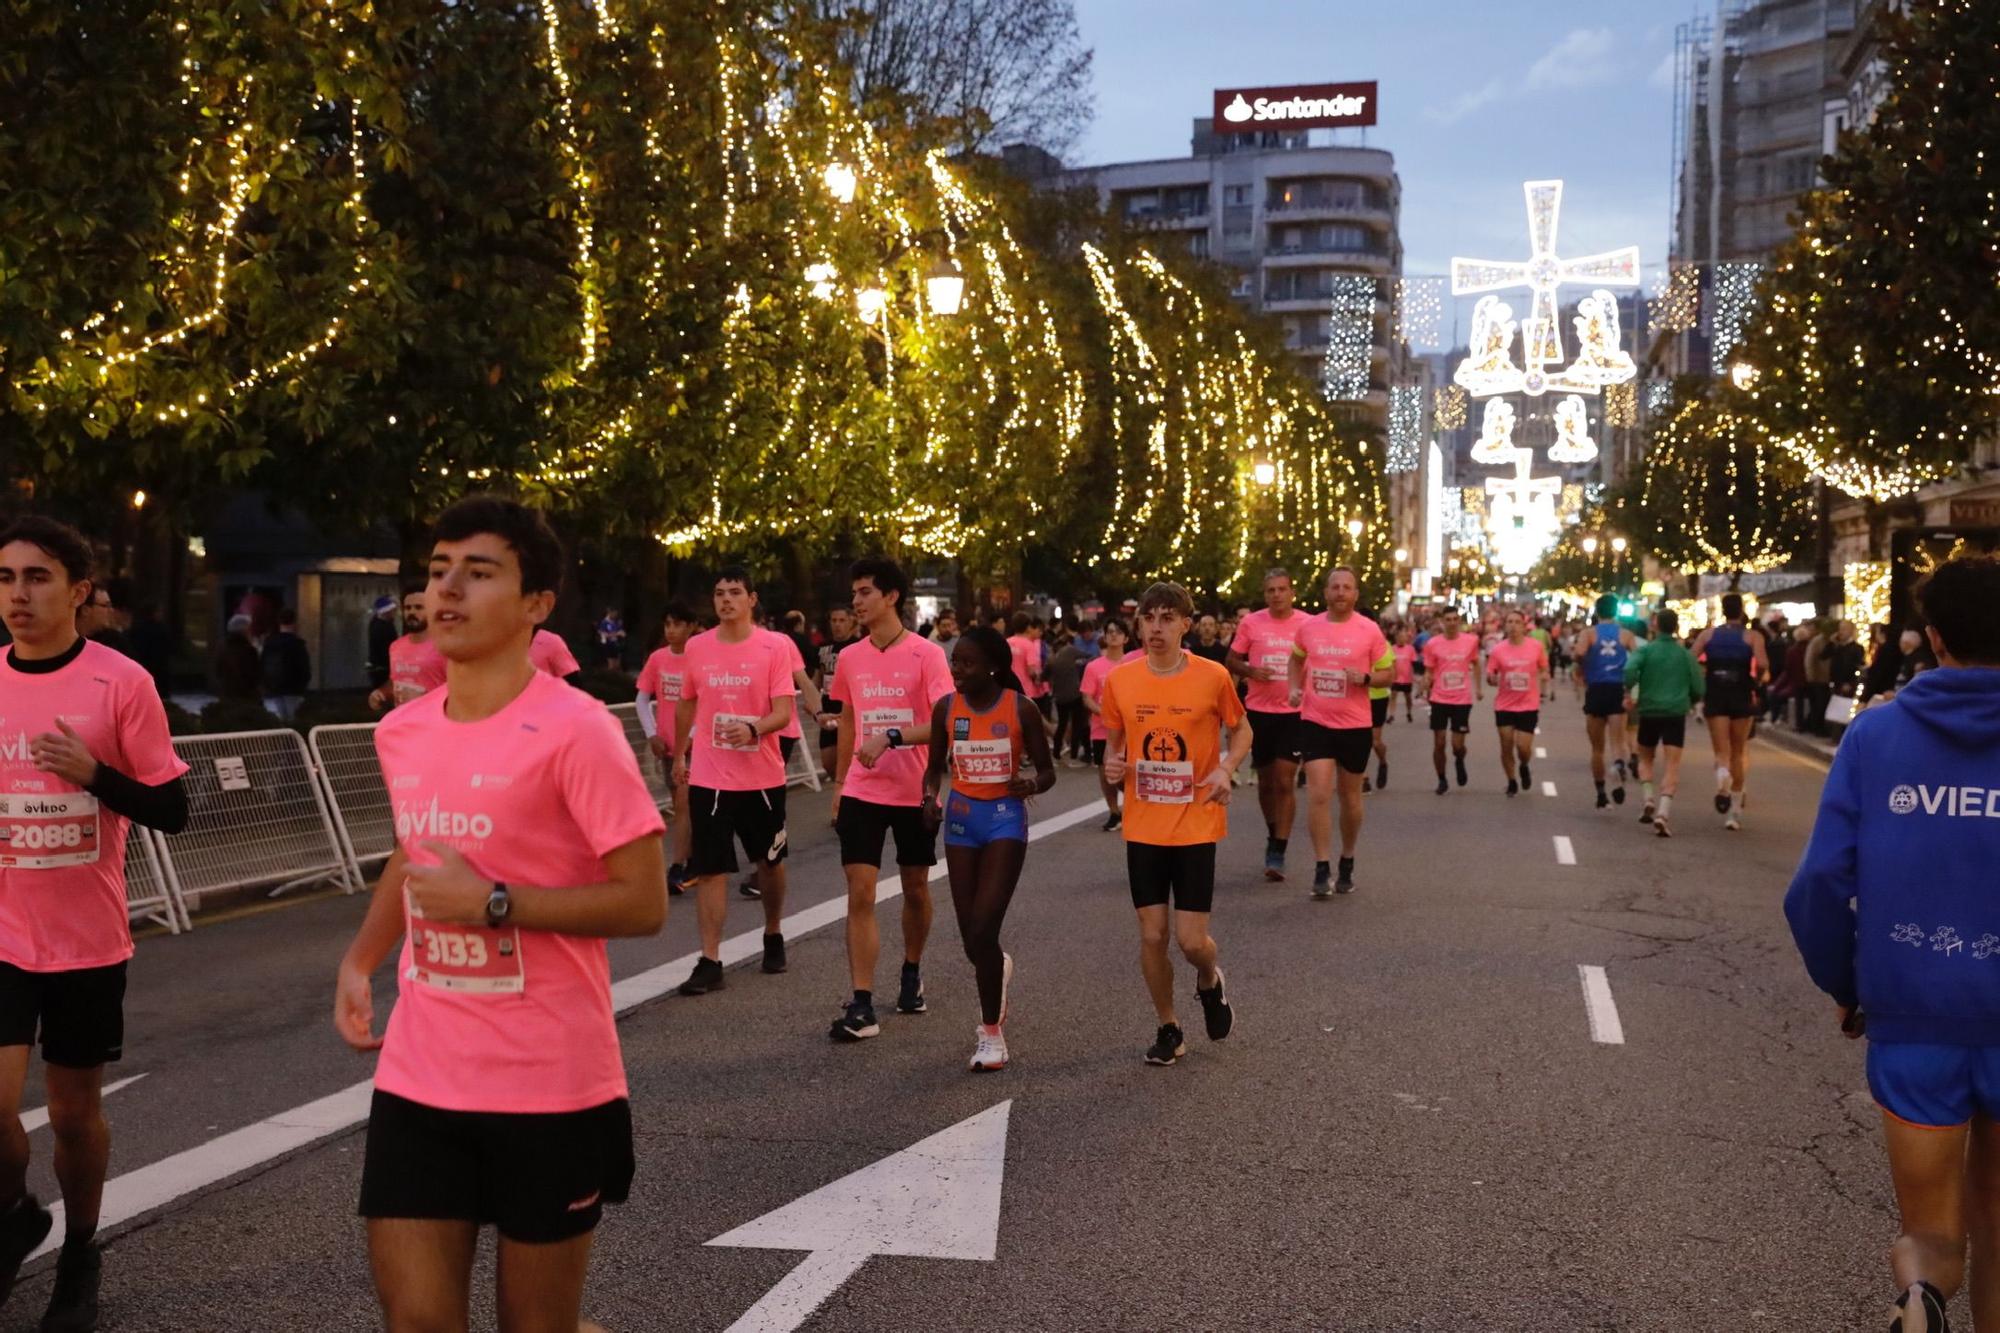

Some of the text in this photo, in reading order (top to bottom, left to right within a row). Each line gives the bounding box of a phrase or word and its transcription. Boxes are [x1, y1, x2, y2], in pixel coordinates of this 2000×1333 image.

[1253, 93, 1366, 121] Santander
[863, 680, 905, 698] OVIEDO
[963, 758, 1002, 773] 3932
[1146, 777, 1184, 793] 3949
[24, 801, 68, 815] OVIEDO
[397, 793, 493, 845] OVIEDO
[10, 823, 81, 849] 2088
[424, 929, 488, 968] 3133
